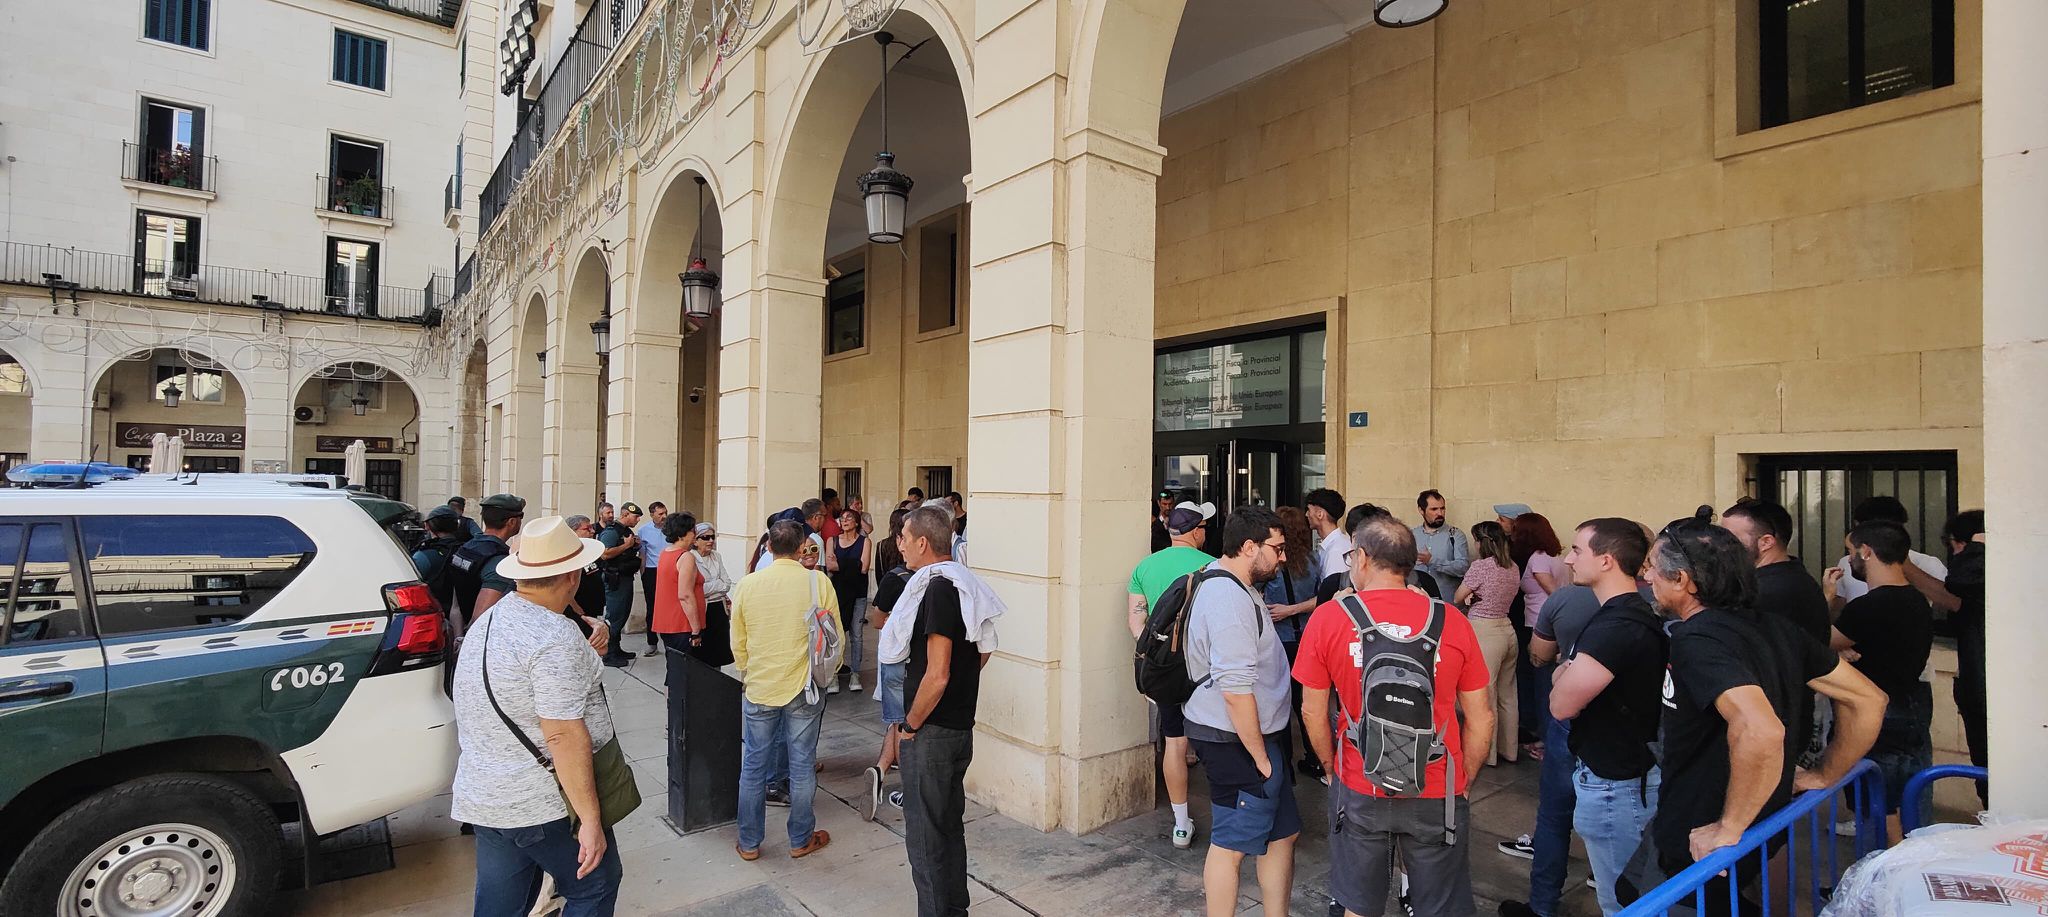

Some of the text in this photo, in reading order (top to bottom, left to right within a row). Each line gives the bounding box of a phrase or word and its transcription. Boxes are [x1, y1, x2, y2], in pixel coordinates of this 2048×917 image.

[1250, 353, 1280, 364] Provincial
[1250, 367, 1280, 378] Provincial
[1255, 389, 1283, 398] Europea
[1355, 414, 1361, 425] 4
[176, 428, 226, 443] Plaza
[232, 432, 242, 443] 2
[291, 662, 345, 689] 062
